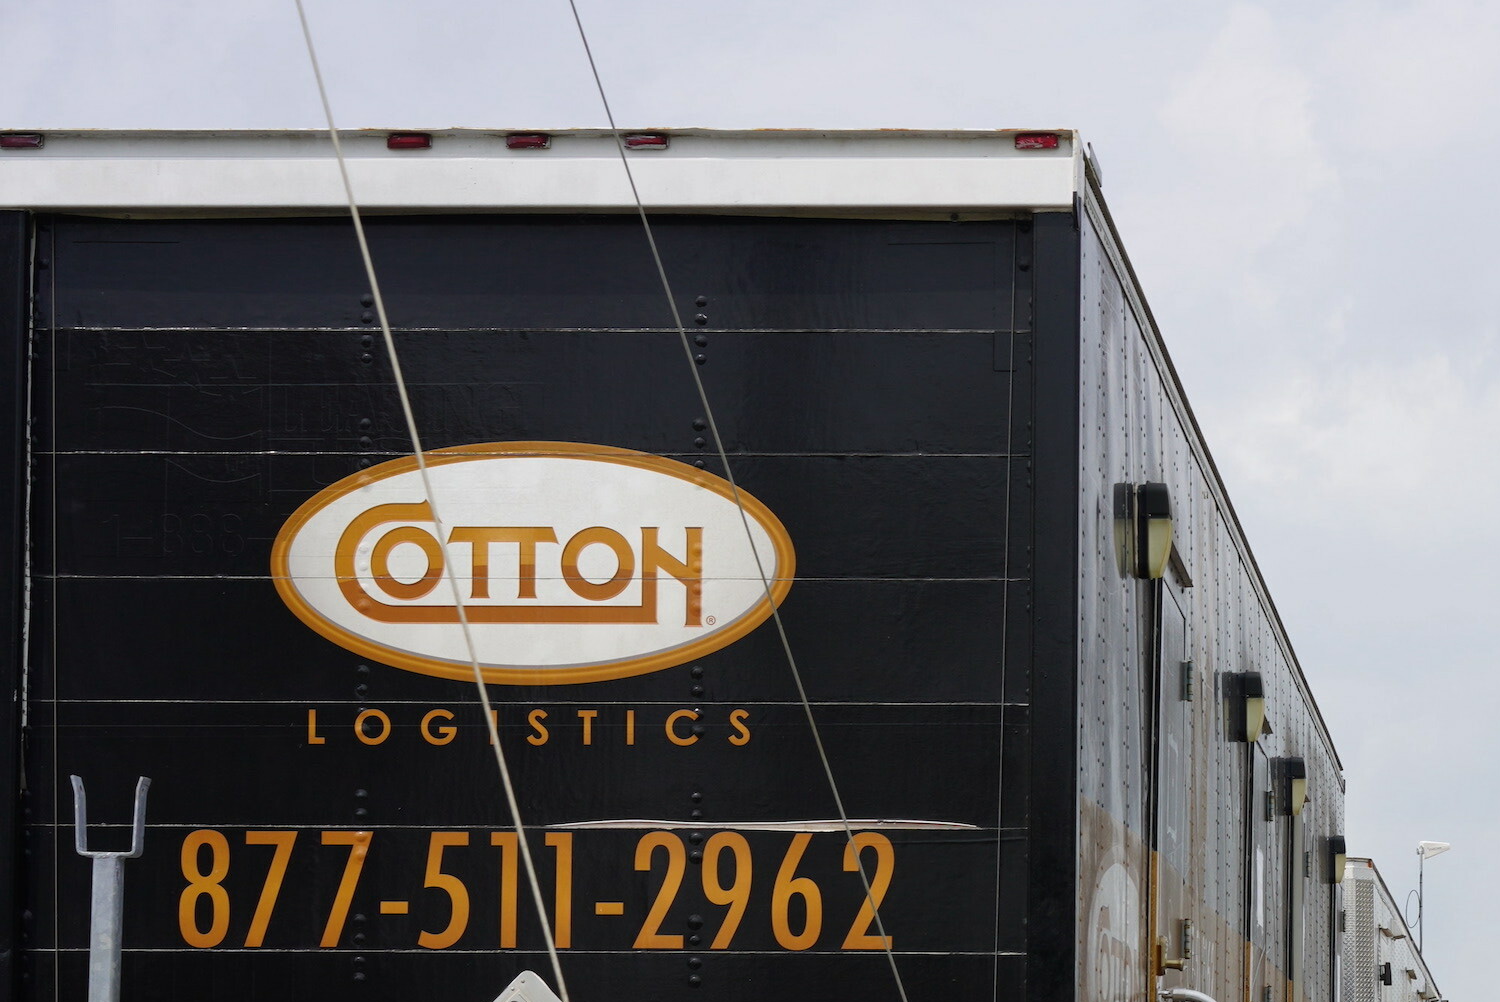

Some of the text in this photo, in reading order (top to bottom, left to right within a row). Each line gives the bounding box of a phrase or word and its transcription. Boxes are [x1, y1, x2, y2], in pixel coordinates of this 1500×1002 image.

[334, 499, 704, 628] COTTON
[307, 709, 752, 746] LOGISTICS
[178, 829, 896, 951] 877-511-2962
